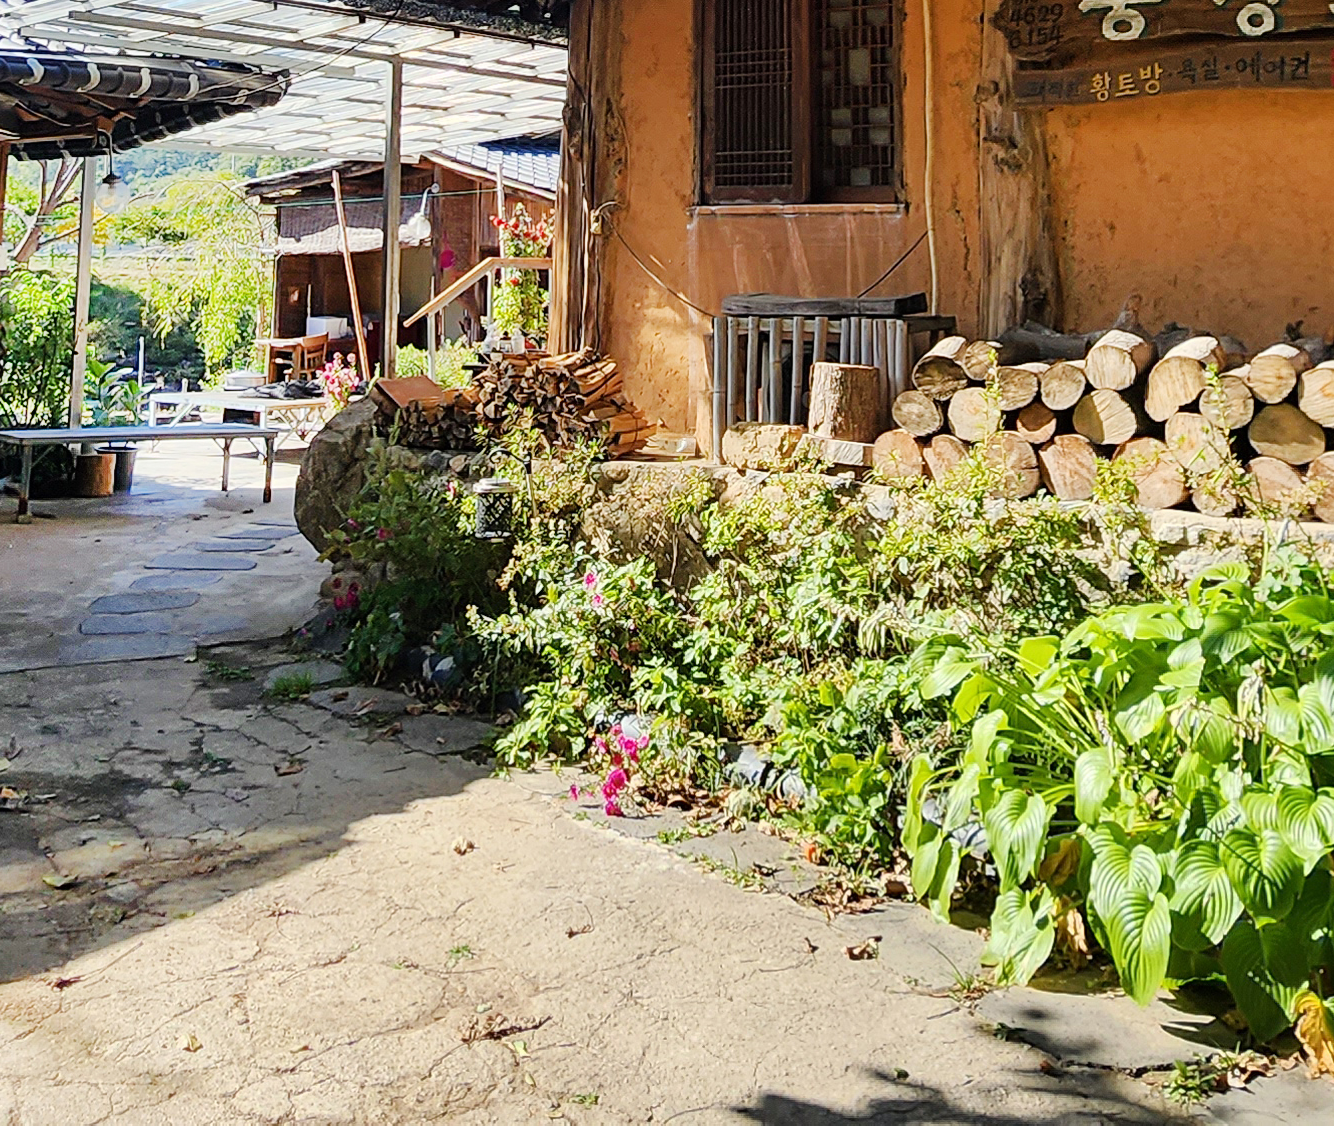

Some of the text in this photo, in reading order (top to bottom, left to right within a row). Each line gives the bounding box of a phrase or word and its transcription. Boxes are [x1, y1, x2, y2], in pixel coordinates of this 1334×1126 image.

[1010, 3, 1064, 26] 4629
[1008, 24, 1064, 49] 6154
[1090, 61, 1164, 102] 황토방
[1235, 49, 1311, 83] 에어컨
